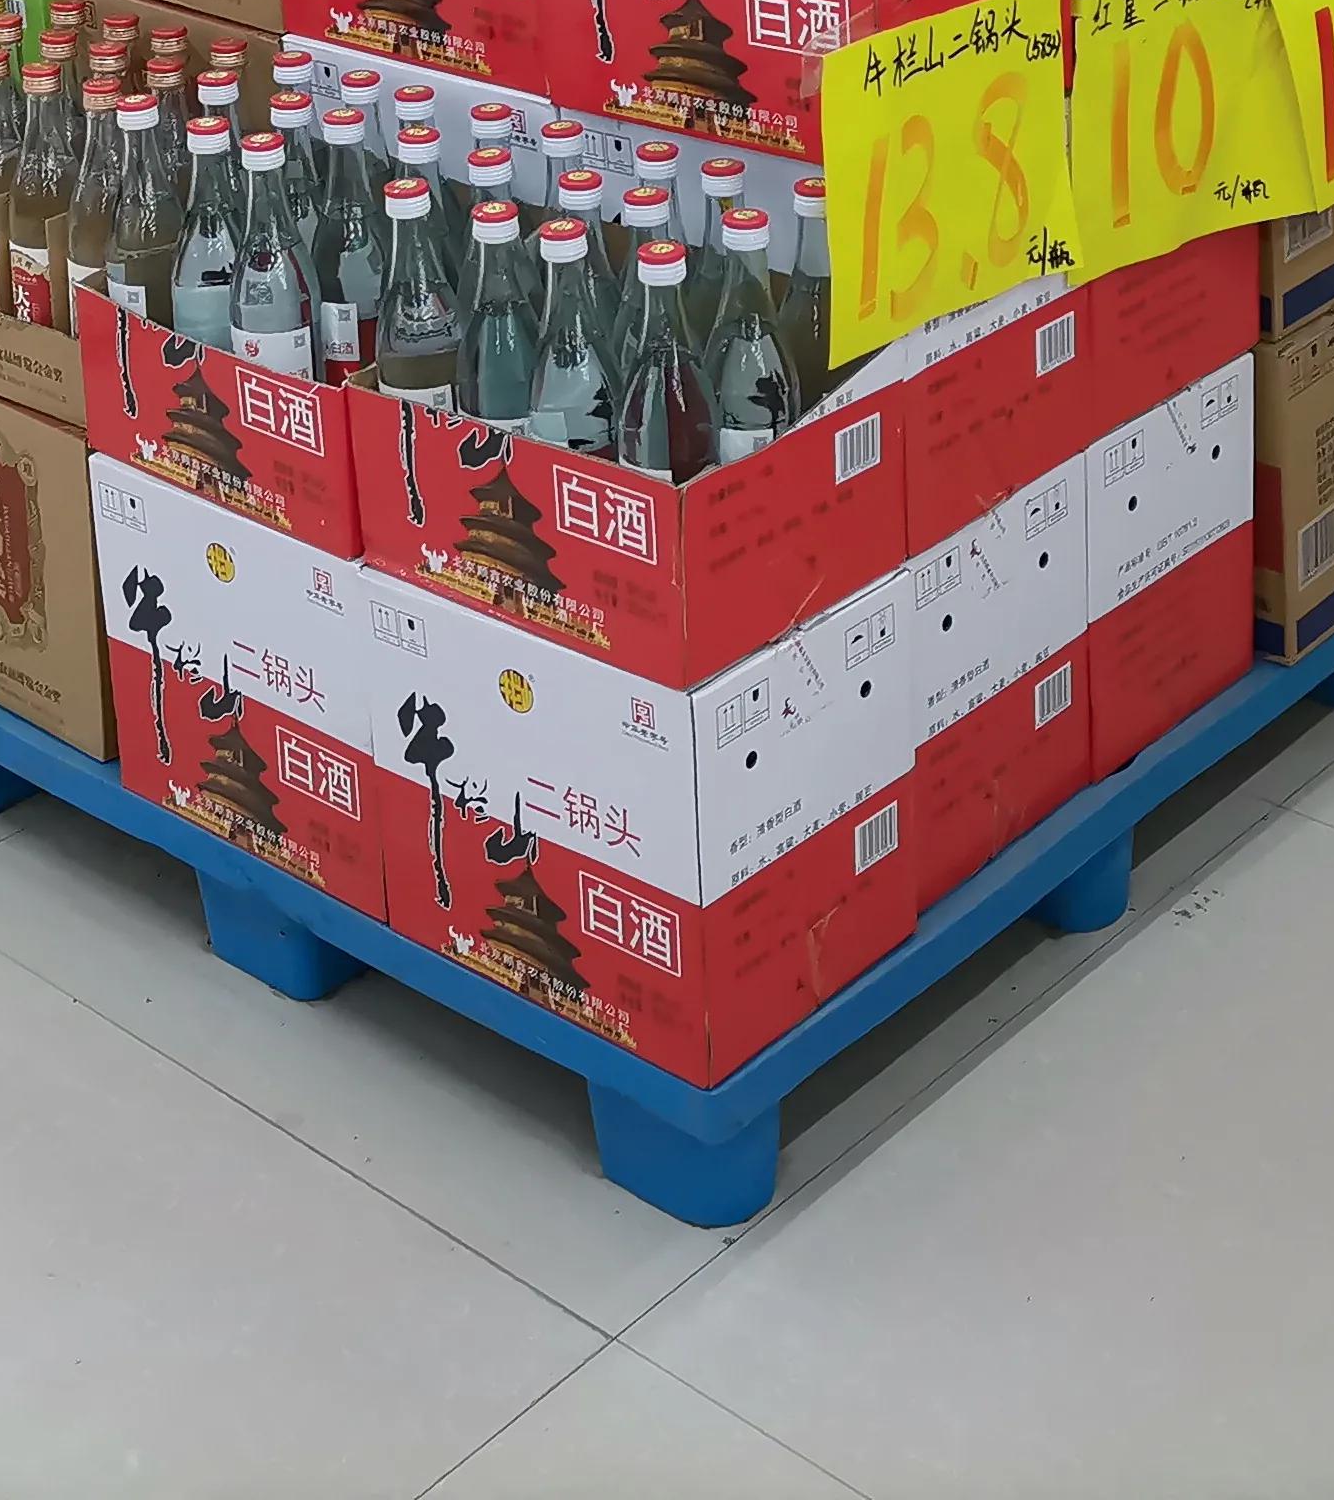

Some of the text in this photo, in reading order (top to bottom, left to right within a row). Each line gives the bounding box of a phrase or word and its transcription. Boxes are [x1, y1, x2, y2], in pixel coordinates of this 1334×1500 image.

[1111, 18, 1215, 229] 10
[240, 379, 318, 450] 白酒
[558, 477, 650, 557] 白酒
[231, 639, 326, 713] 二锅头
[282, 738, 355, 813] 白酒
[524, 776, 643, 858] 二锅头
[585, 884, 675, 969] 白酒
